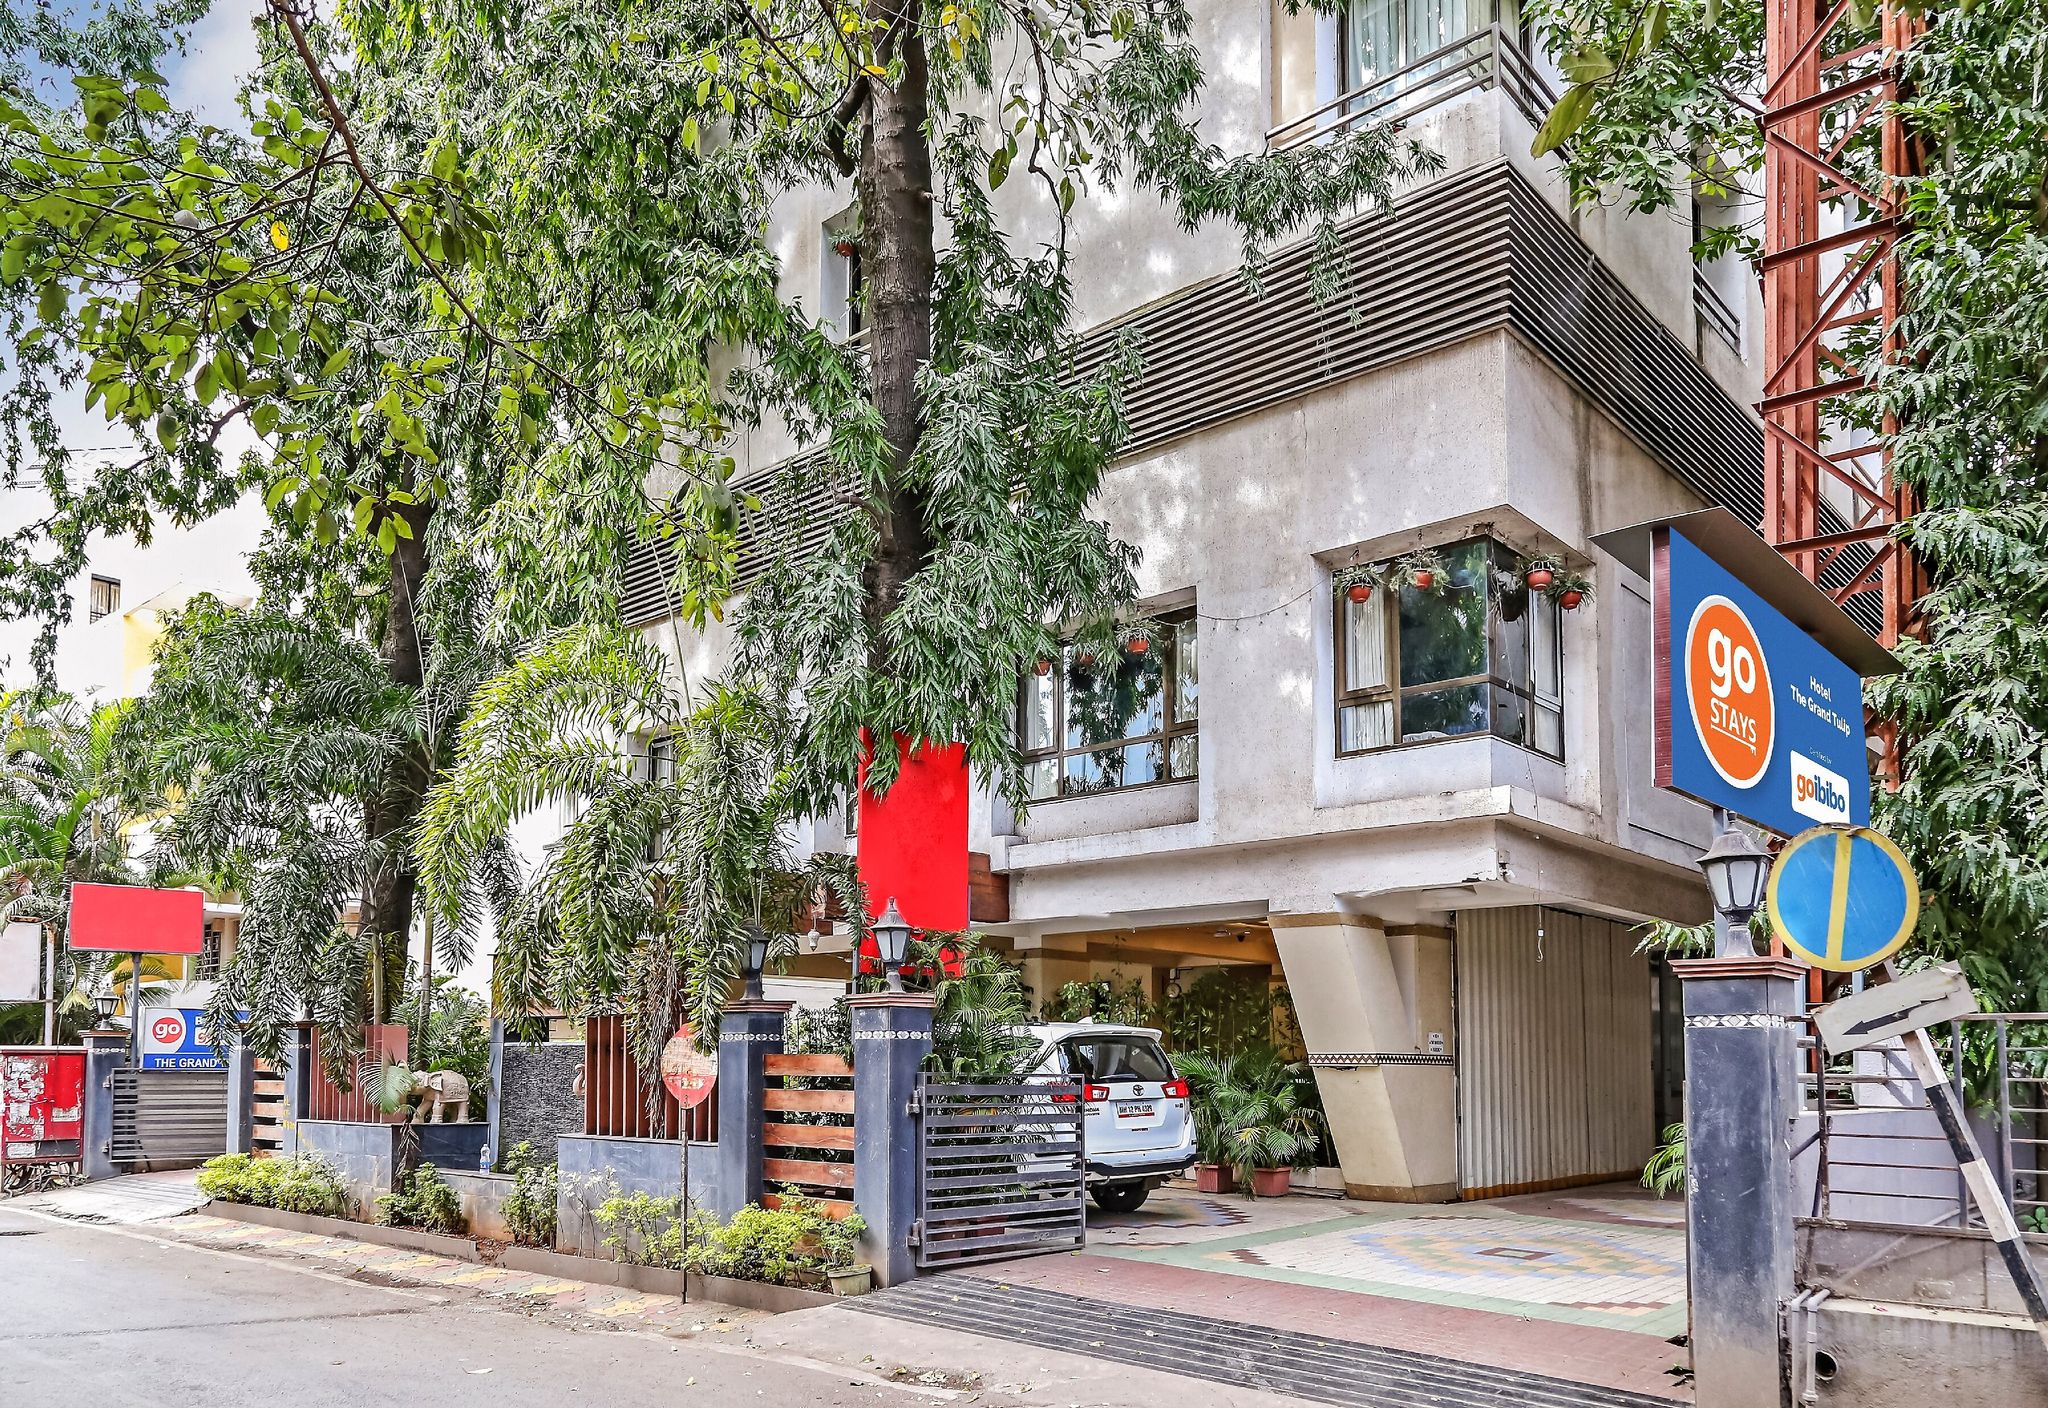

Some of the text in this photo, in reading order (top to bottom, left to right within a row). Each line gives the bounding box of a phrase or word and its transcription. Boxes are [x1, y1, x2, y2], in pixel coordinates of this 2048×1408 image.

[1708, 628, 1756, 698] go
[1810, 676, 1832, 702] Hotel
[1711, 697, 1757, 743] STAYS
[1790, 684, 1851, 738] The Grand Tulip
[1797, 774, 1846, 813] goibibo
[155, 1023, 180, 1039] go
[155, 1058, 176, 1068] THE
[179, 1058, 217, 1068] GRAND
